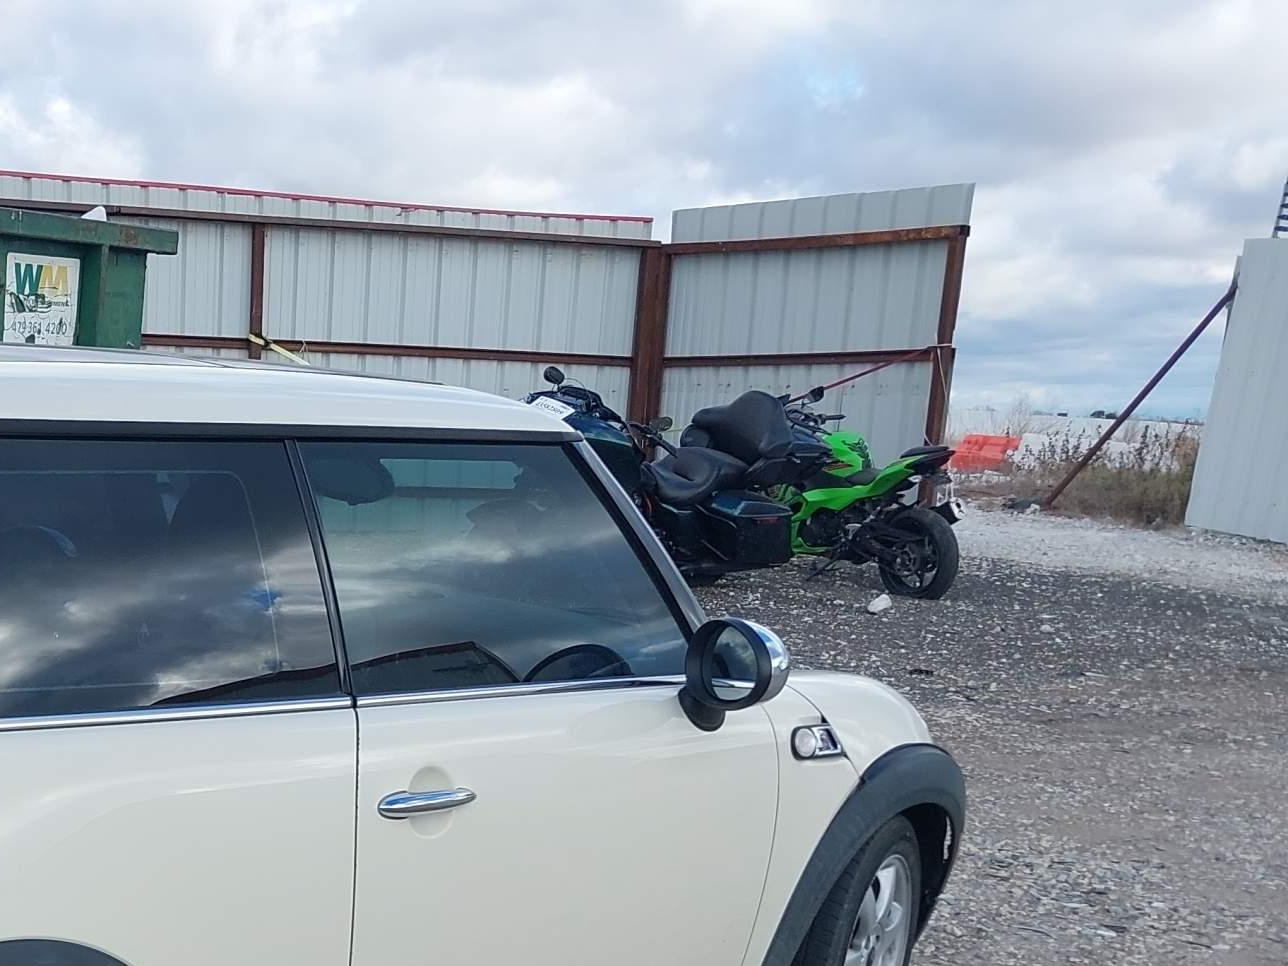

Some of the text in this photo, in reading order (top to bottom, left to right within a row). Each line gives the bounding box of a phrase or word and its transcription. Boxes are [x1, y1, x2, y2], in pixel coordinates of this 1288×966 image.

[14, 262, 69, 297] WM
[12, 321, 68, 335] 479 361 4200
